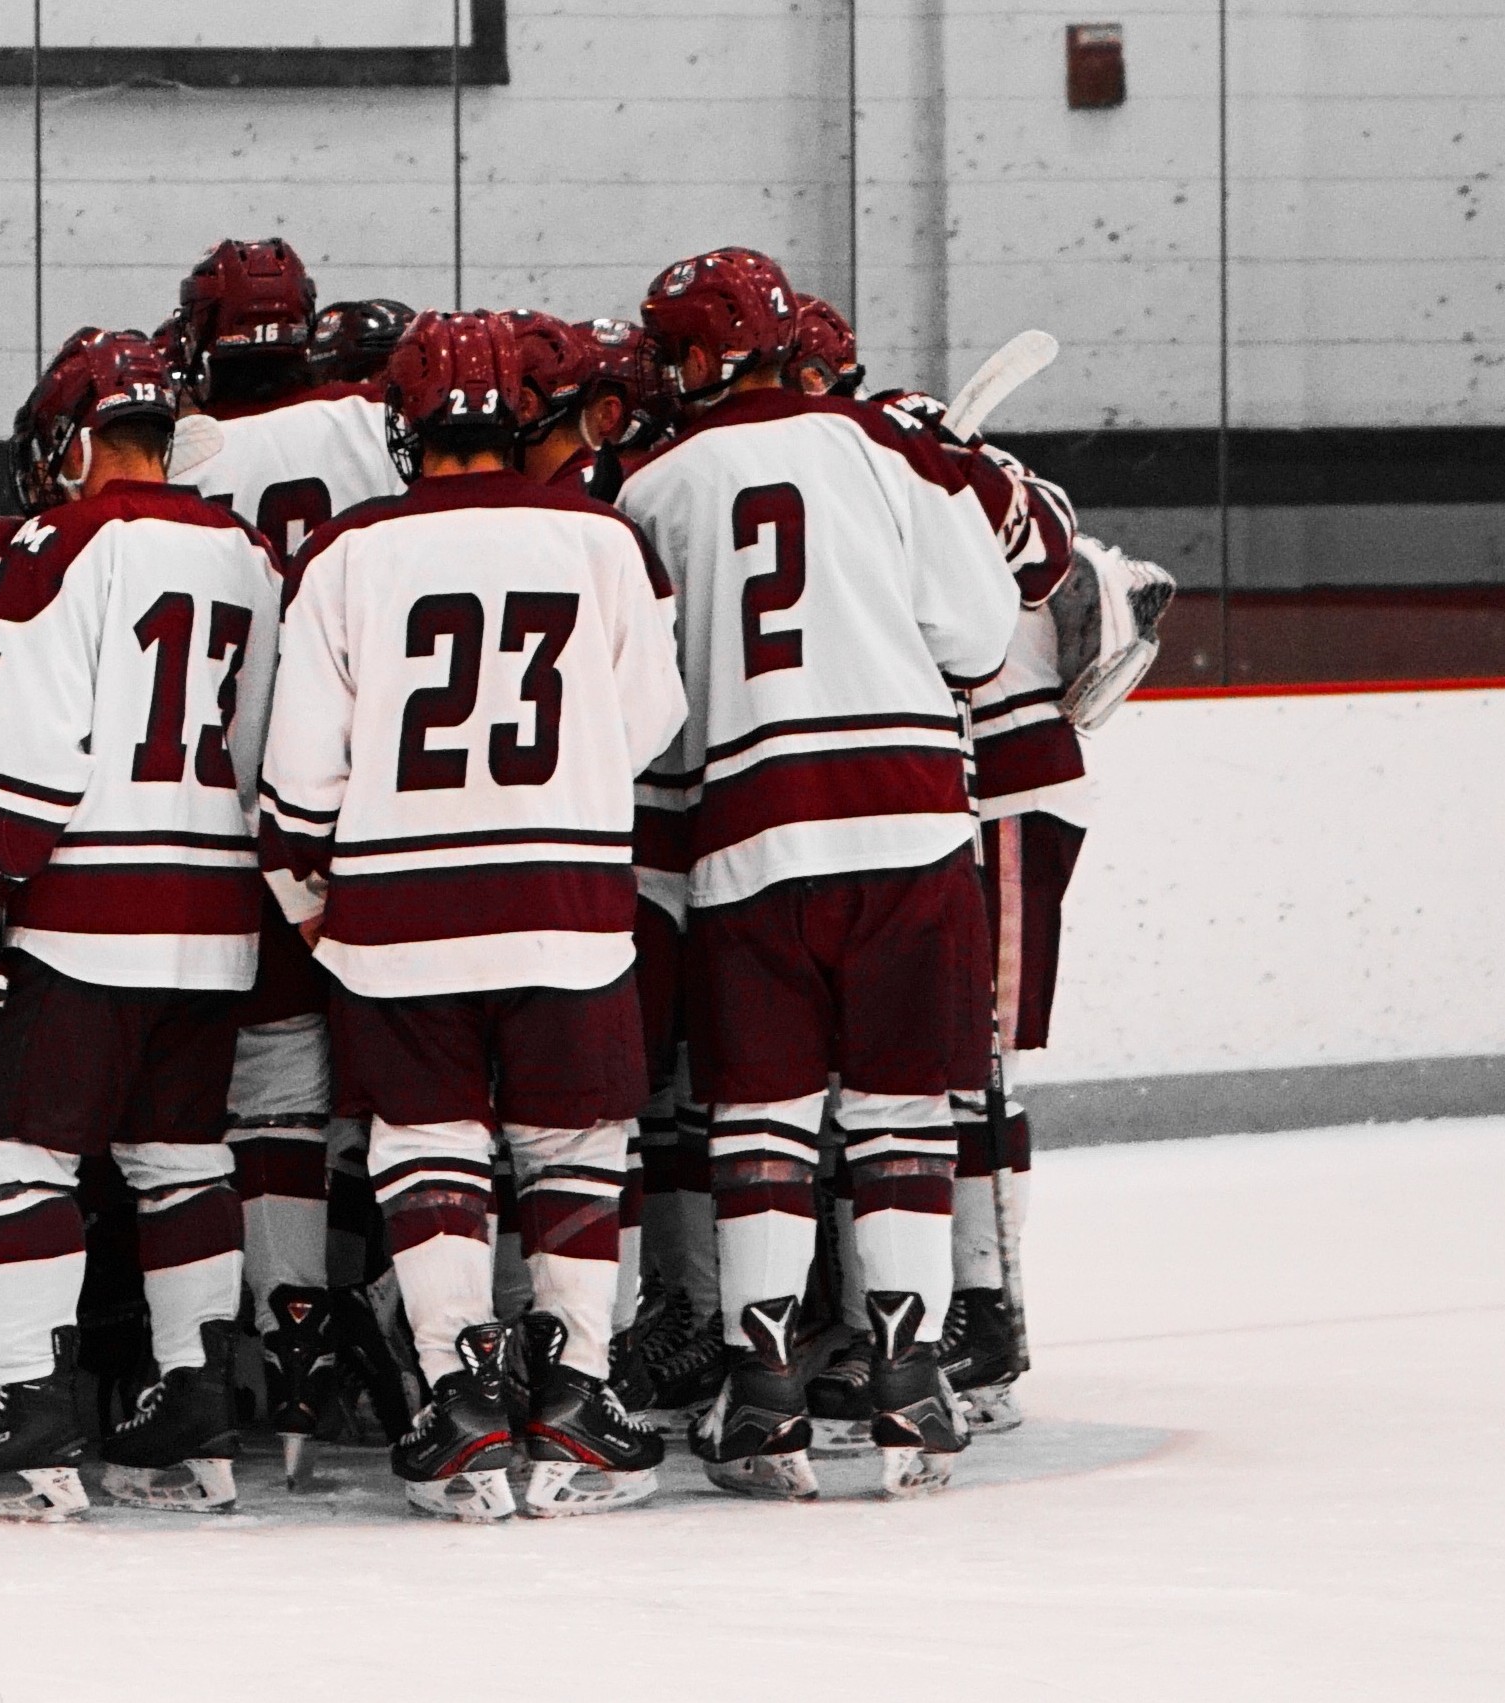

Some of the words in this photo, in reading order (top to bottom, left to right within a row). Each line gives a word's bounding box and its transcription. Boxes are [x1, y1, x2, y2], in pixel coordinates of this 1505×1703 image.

[254, 322, 279, 343] 16
[771, 287, 788, 313] 2
[133, 382, 156, 400] 13
[732, 481, 806, 681] 2
[133, 591, 253, 789] 13
[397, 591, 580, 792] 23
